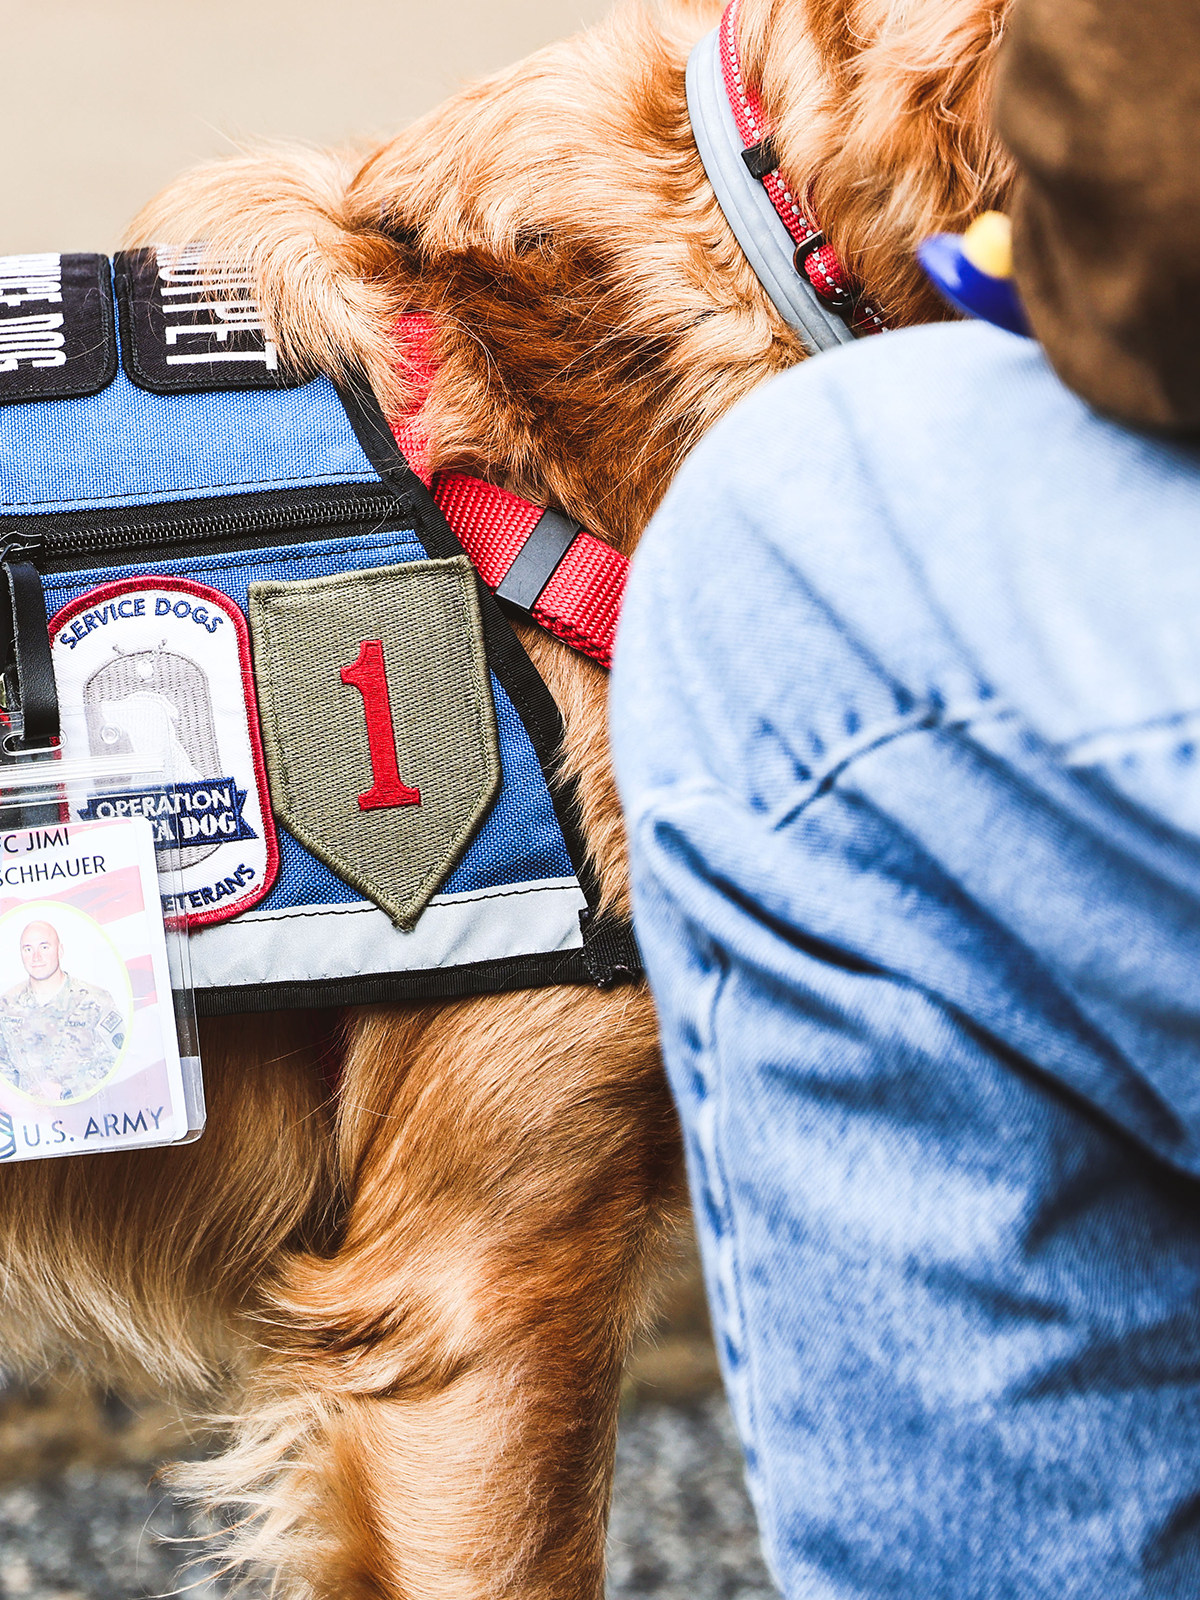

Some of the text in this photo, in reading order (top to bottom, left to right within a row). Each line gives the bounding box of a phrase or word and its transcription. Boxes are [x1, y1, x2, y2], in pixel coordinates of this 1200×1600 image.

[162, 300, 278, 370] PET
[60, 597, 224, 649] SERVICE DOGS
[340, 639, 422, 811] 1
[96, 787, 232, 818] OPERATION
[26, 827, 70, 852] JIMI
[180, 811, 237, 840] DOG
[160, 863, 256, 909] ETERANS
[23, 1106, 164, 1147] U.S. ARMY
